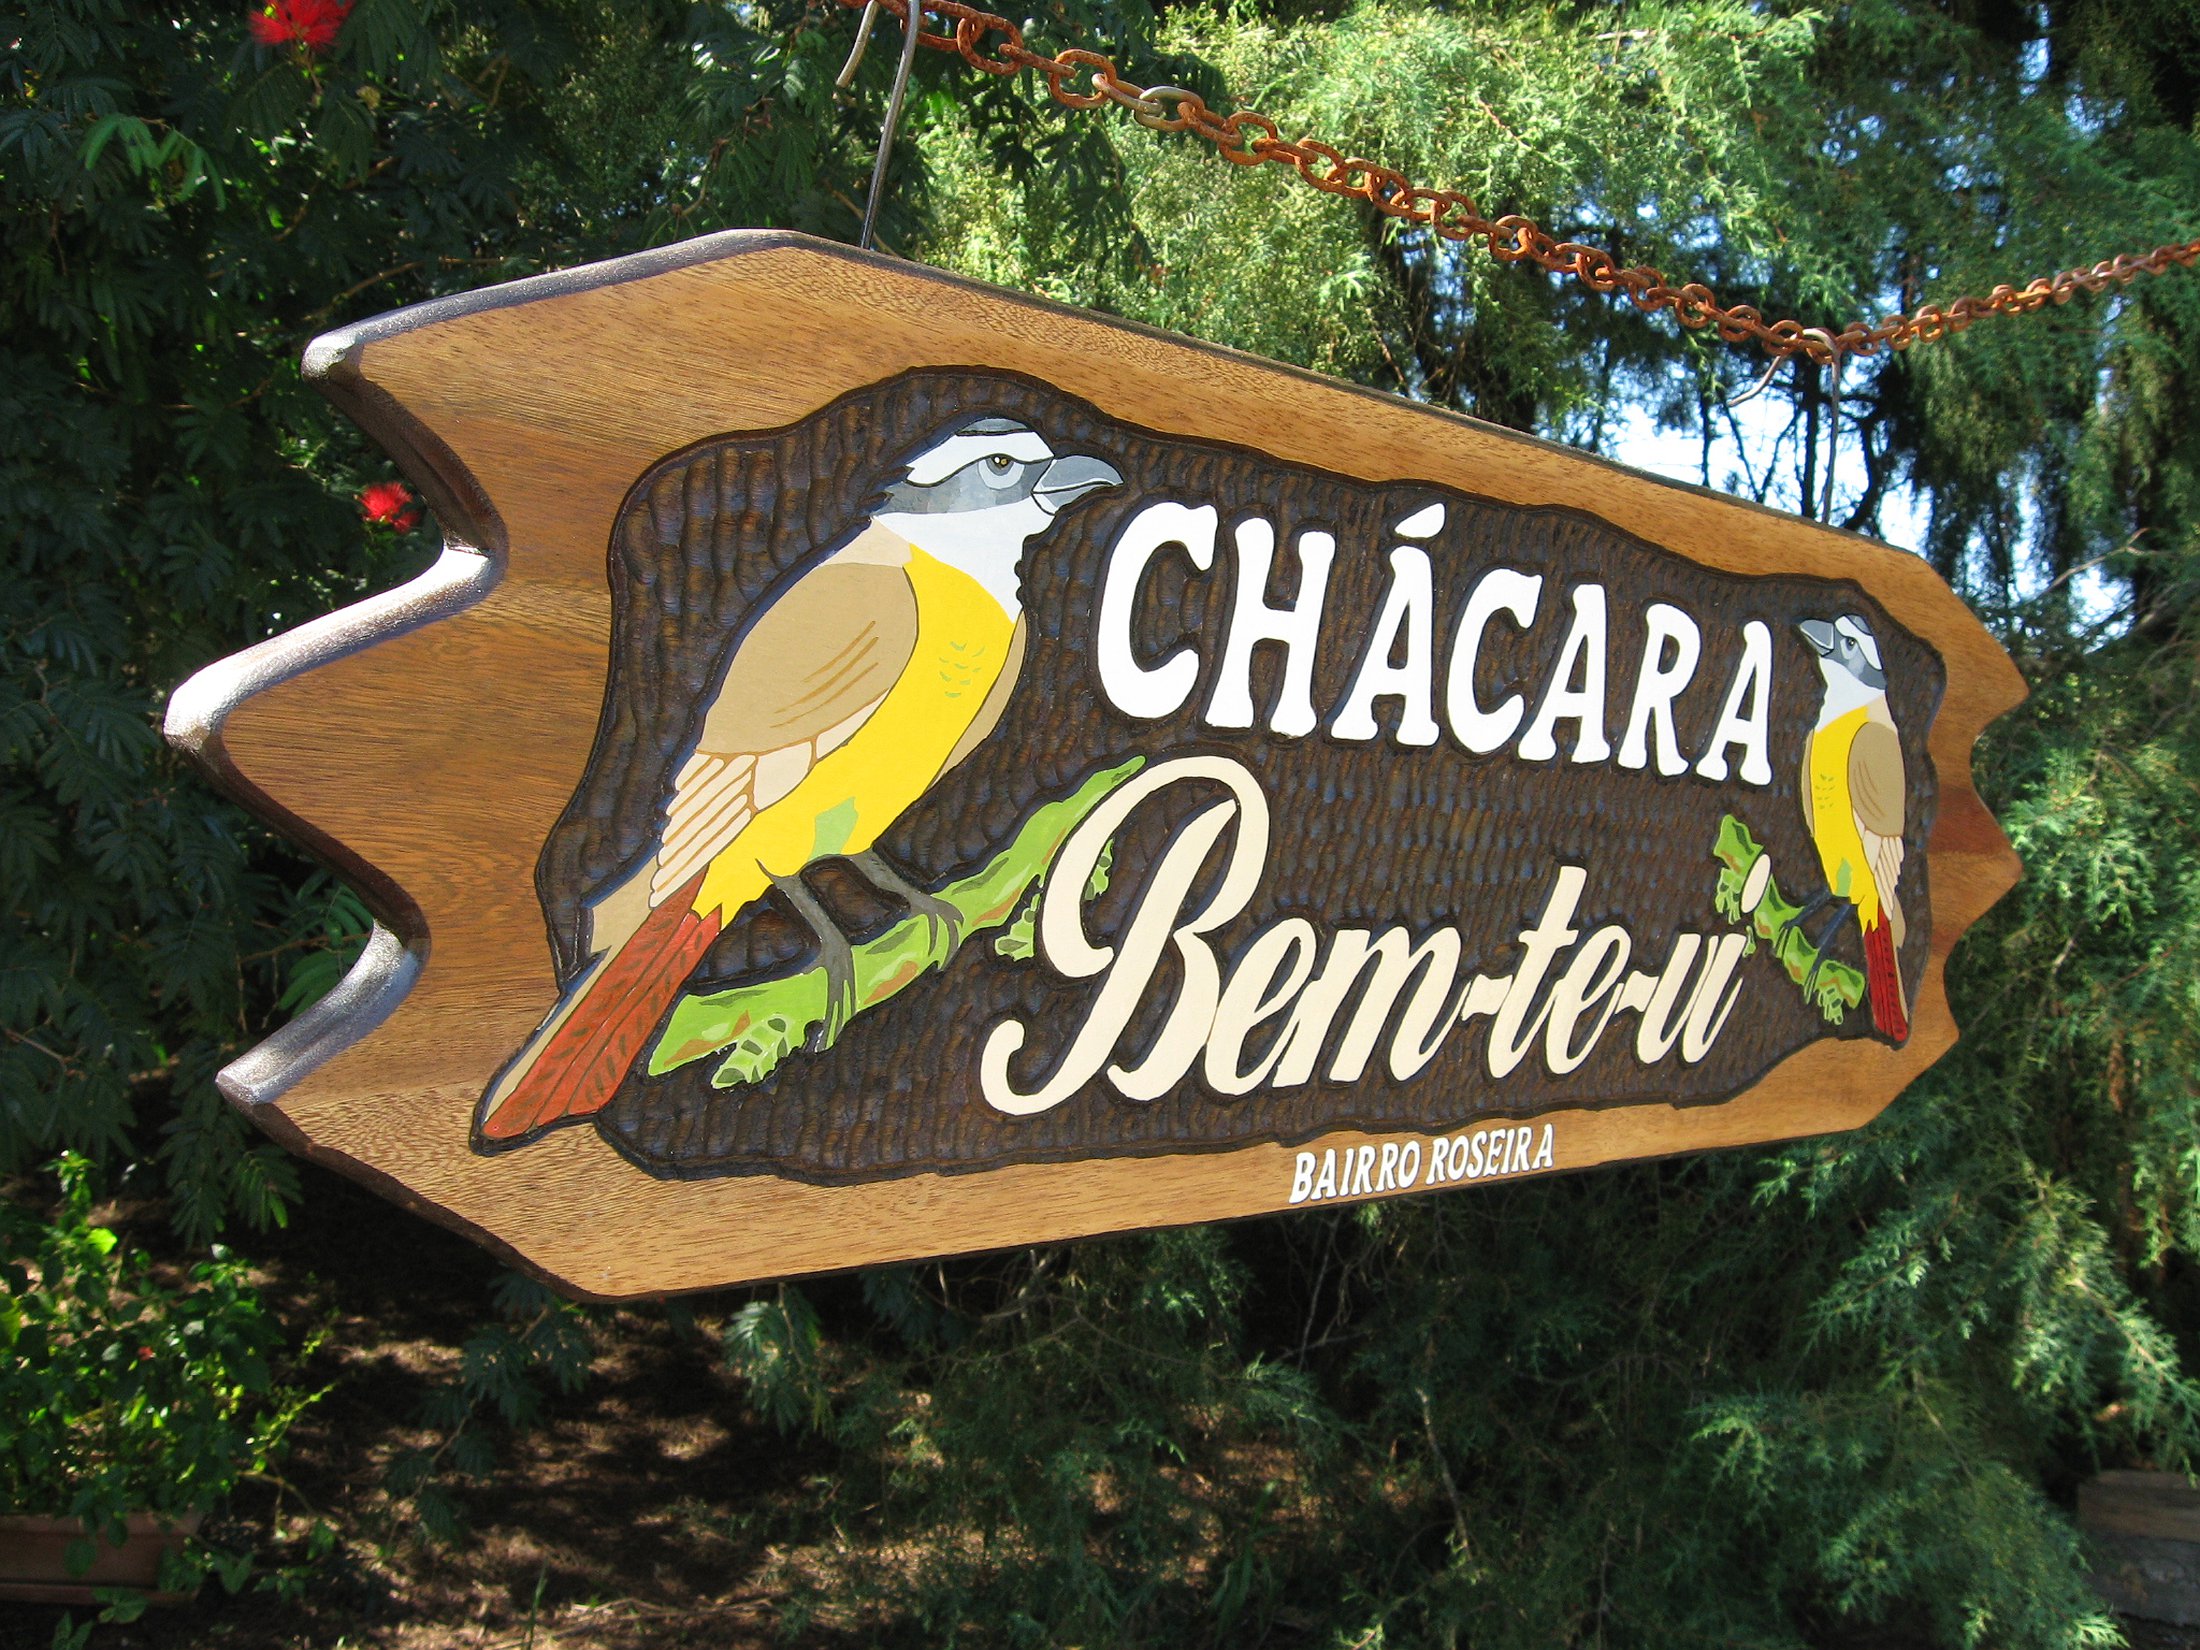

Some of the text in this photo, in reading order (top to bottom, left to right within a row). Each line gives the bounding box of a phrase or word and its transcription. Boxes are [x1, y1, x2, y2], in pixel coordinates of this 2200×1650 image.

[1097, 502, 1772, 786] CHÁCARA
[981, 755, 1770, 1116] Bem-te-vi
[1288, 1123, 1554, 1204] BAIRRO ROSEIRA
